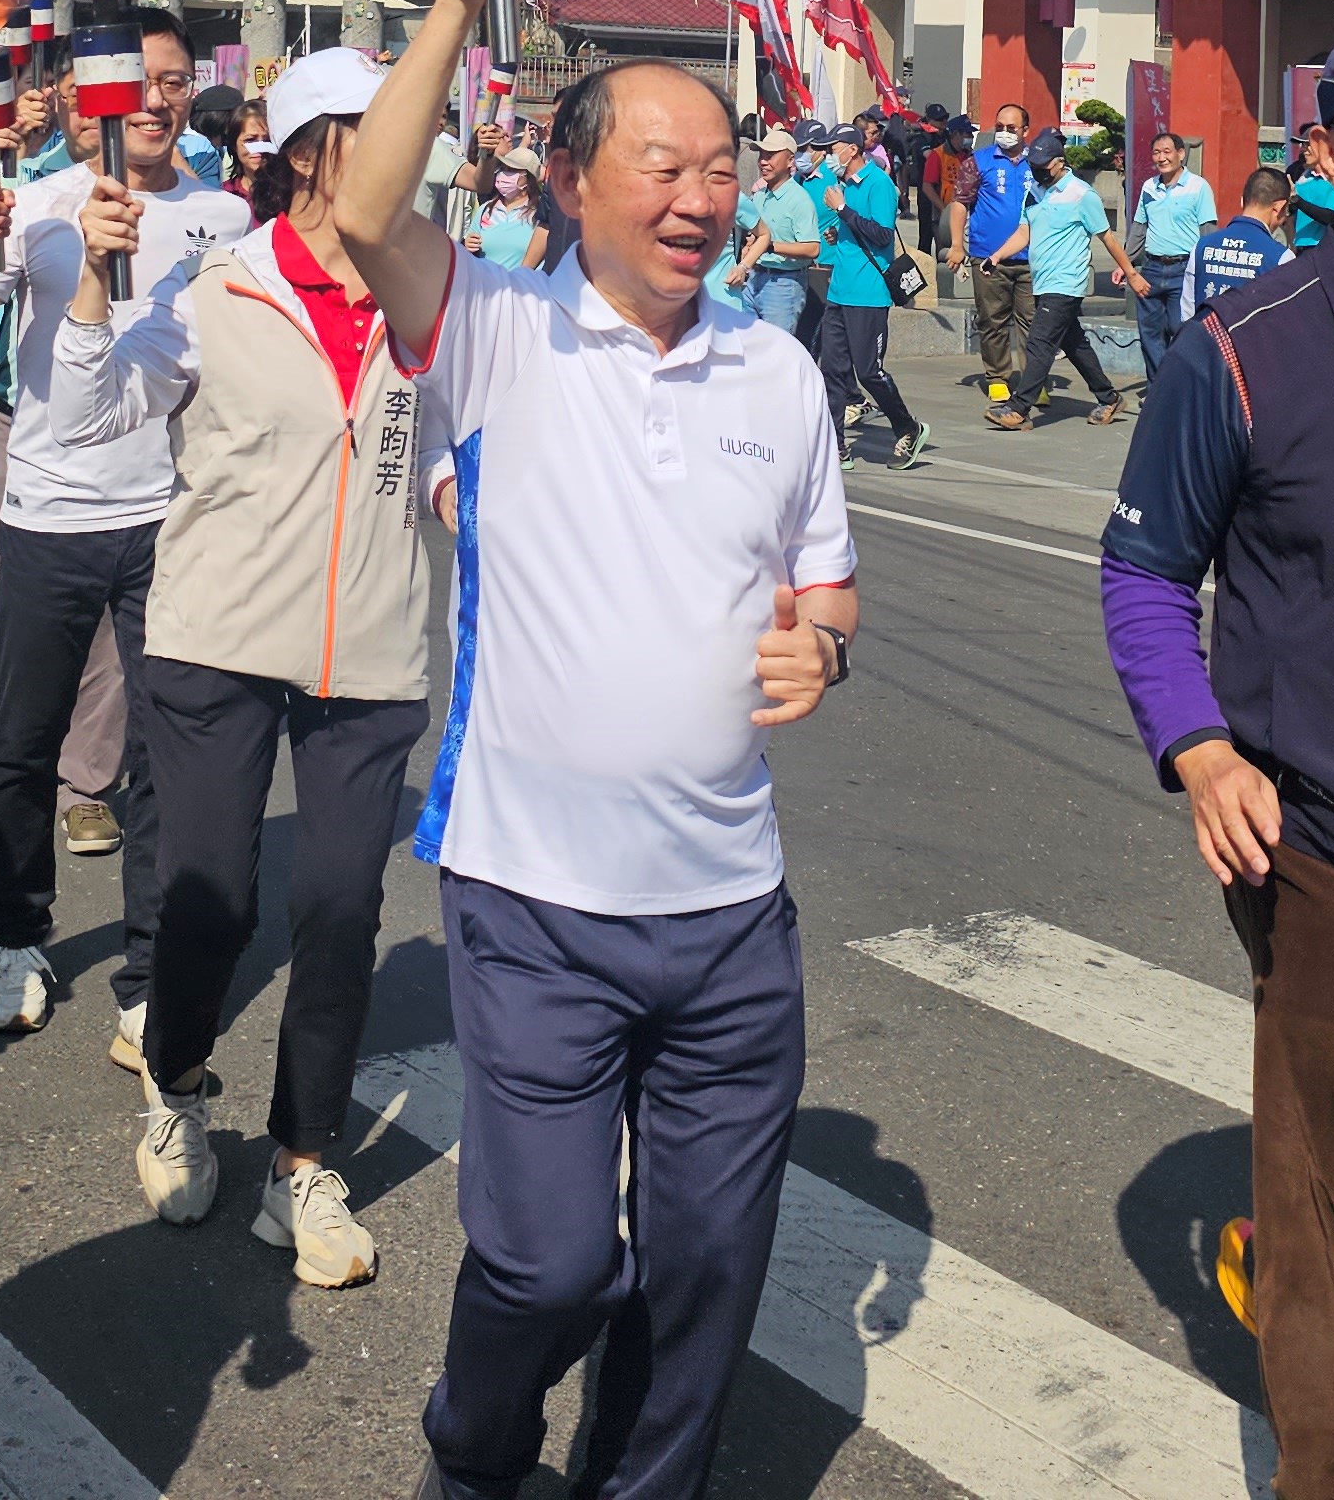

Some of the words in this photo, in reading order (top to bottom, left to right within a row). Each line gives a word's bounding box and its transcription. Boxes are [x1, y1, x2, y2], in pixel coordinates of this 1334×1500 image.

[1222, 237, 1247, 249] KMT
[375, 388, 413, 496] 李昀芳
[719, 436, 776, 464] LIUGDUI
[1113, 494, 1143, 525] 火組
